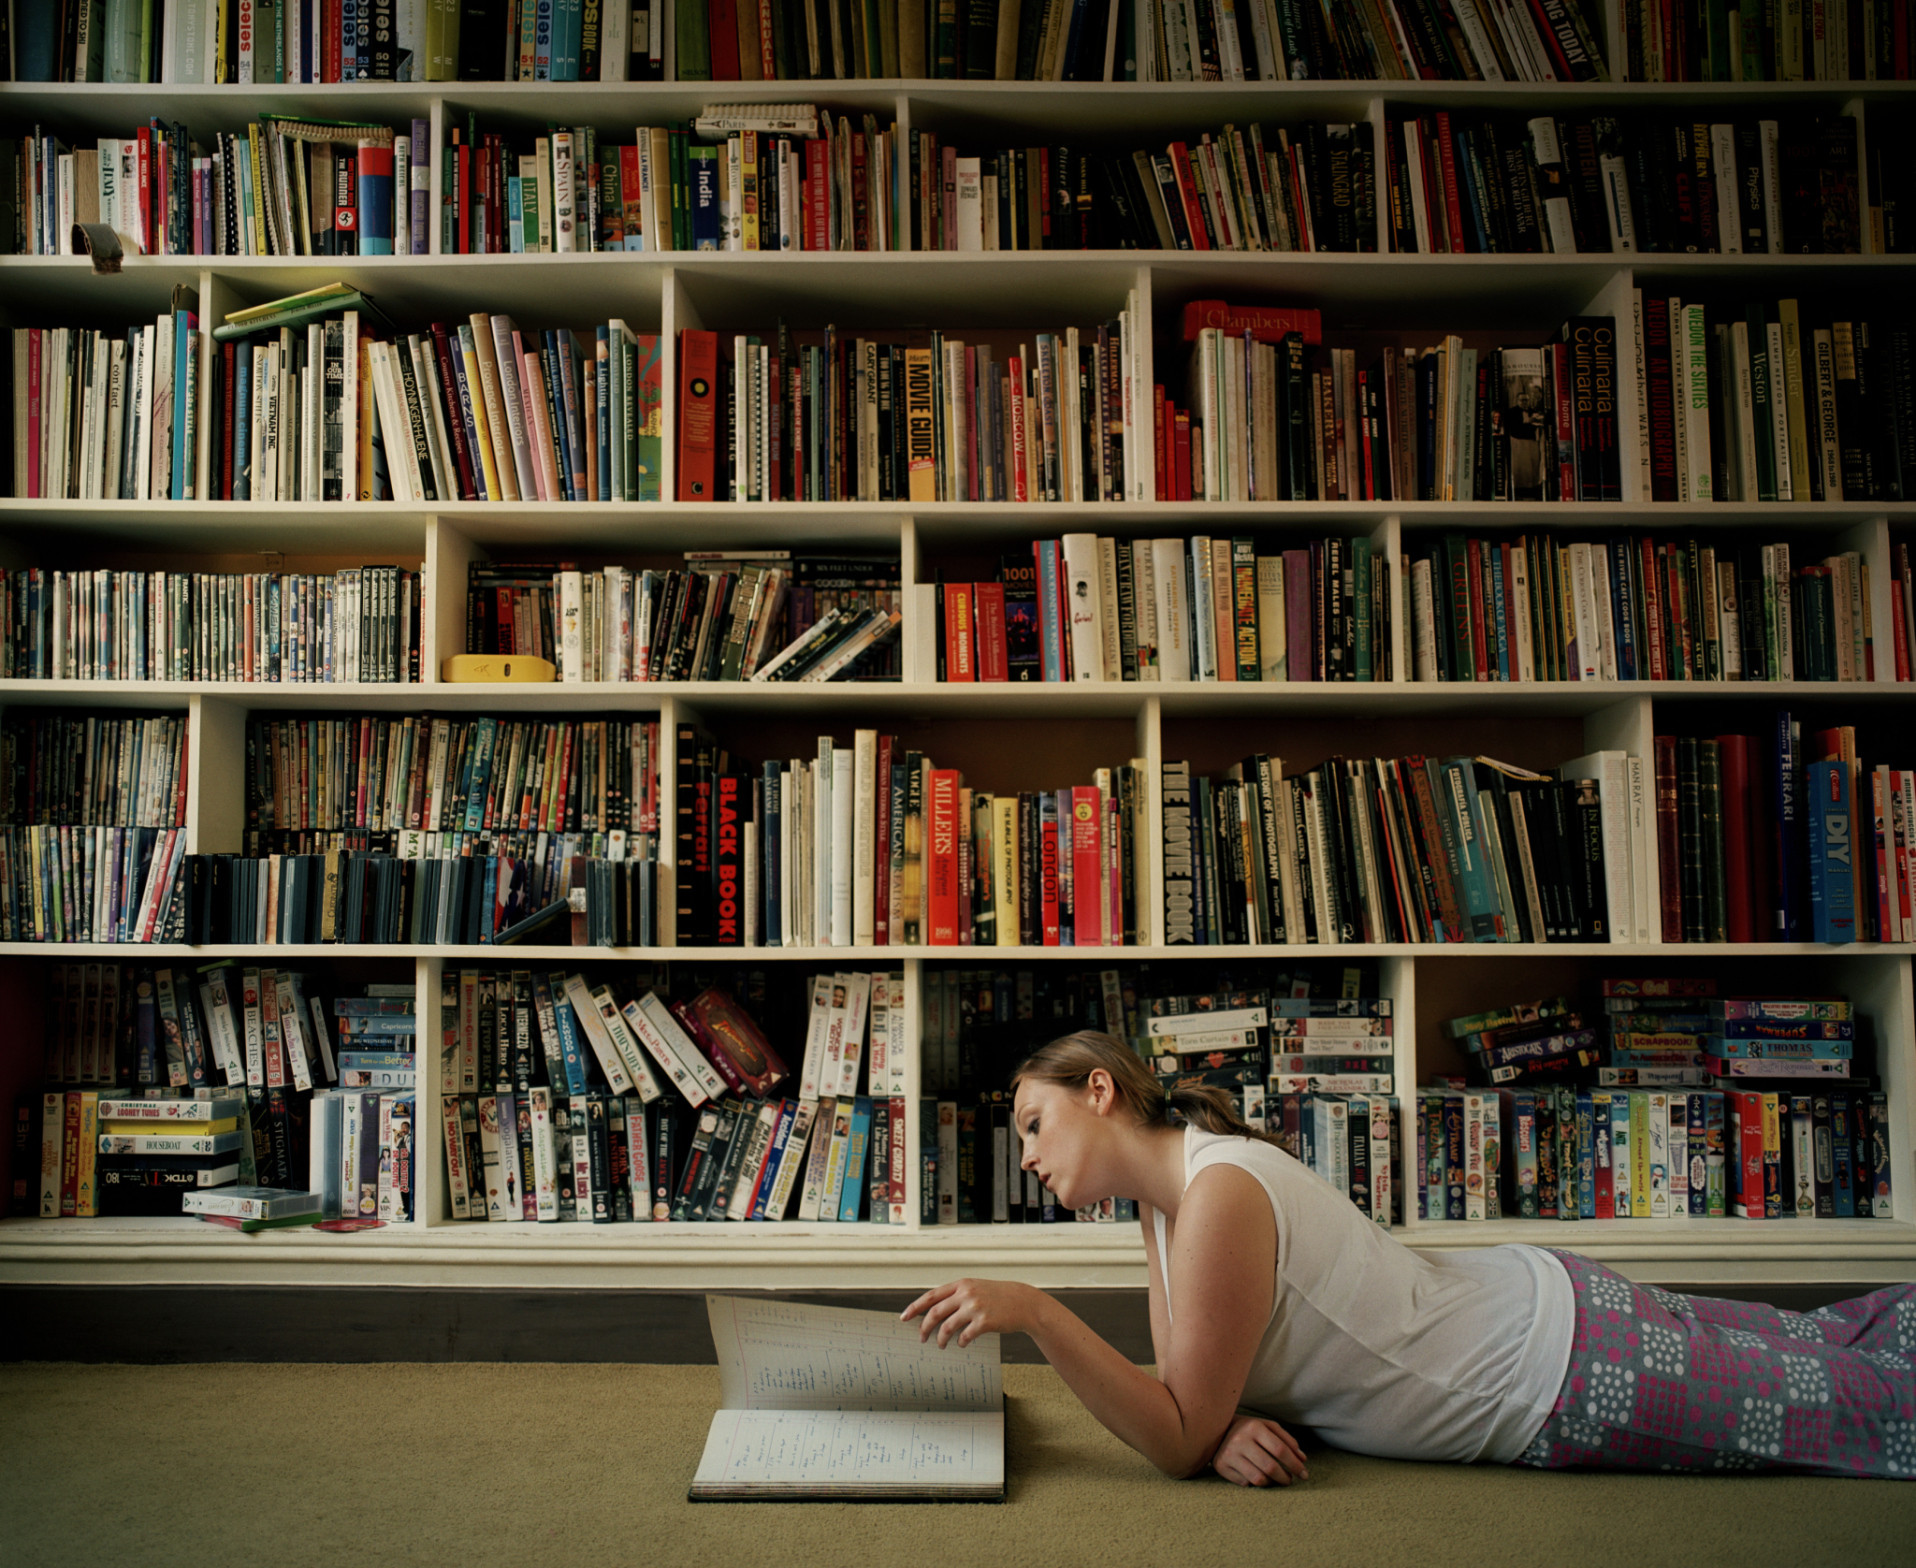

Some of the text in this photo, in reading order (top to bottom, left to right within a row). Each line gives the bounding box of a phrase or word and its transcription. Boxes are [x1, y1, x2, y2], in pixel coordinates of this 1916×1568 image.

[240, 0, 251, 52] selec
[582, 25, 596, 51] BOOK
[1556, 23, 1588, 65] TODAY
[343, 57, 355, 65] 52
[357, 56, 369, 64] 53
[376, 52, 389, 61] 50
[521, 55, 534, 63] 51
[537, 56, 549, 64] 52
[1575, 124, 1598, 176] ROTTEN
[1693, 123, 1706, 177] HEPBURN
[337, 158, 349, 207] THE RUNNER
[522, 181, 537, 214] ITALY
[557, 161, 569, 203] SPAIN
[602, 164, 617, 203] China
[698, 170, 712, 208] India
[730, 165, 740, 190] ROME
[1330, 150, 1350, 207] STALINGRAD
[1505, 150, 1526, 233] FIRST WORLD WAR
[1676, 173, 1692, 224] CLIFT
[1747, 167, 1762, 210] Physics
[1614, 171, 1630, 239] NOTORIOUS
[1206, 309, 1290, 330] Chambers
[866, 345, 876, 405] CARY GRANT
[1109, 336, 1120, 390] HILLERMAN
[1574, 326, 1595, 413] Culinaria
[1593, 327, 1614, 414] Culinaria
[1688, 307, 1708, 409] AVEDON THE SIXTIES
[1752, 352, 1767, 404] Weston
[1786, 322, 1800, 398] August Sander
[1817, 342, 1832, 387] GILBERT
[440, 356, 464, 454] Country Kitchens & Recipes
[457, 372, 476, 428] BARNS
[482, 361, 506, 457] Provence Interiors
[502, 360, 526, 446] London Interiors
[598, 368, 609, 408] Lighting
[1040, 345, 1053, 426] SKELETON COAST
[1321, 375, 1334, 440] BAKERY
[1646, 299, 1674, 478] AVEDON AN AUTOBIOGRAPHY
[1772, 331, 1787, 466] HELMUT NEWTON PORTRAITS
[237, 366, 248, 466] magnum cinema
[268, 395, 277, 450] VIETNAM INC.
[403, 372, 428, 461] HOYNINGEN-HUENE
[626, 395, 634, 441] REVEALED
[728, 392, 737, 462] LIGHTING
[909, 364, 932, 461] MOVIE GUIDE
[1012, 394, 1024, 453] MOSCOW
[1561, 399, 1571, 428] home
[1820, 400, 1836, 443] GEORGE
[1828, 472, 1837, 487] 1980
[1003, 567, 1035, 580] 1001
[1330, 541, 1340, 615] REBEL MALES
[1616, 544, 1631, 644] THE RIVER CAFE COOK BOOK
[1235, 566, 1257, 666] IMMEDIATE ACTION
[1452, 561, 1469, 641] GREENS
[957, 592, 969, 674] CURIOUS MOMENTS
[880, 749, 889, 842] VICTORIAN INTERIOR STYLE
[908, 769, 920, 808] VOGUE
[1259, 762, 1272, 799] HISTORY
[1263, 800, 1272, 812] OF
[1451, 768, 1473, 841] FOTOGRAFÍA PÚBLICA
[1631, 762, 1642, 804] MAN RAY
[1781, 754, 1794, 821] FERRARI
[1831, 777, 1839, 801] Collins
[695, 782, 710, 872] Ferrari
[935, 777, 952, 855] MILLER'S
[1292, 787, 1306, 859] SMALLER GARDEN
[1588, 809, 1600, 861] IN FOCUS
[1825, 814, 1850, 865] DIY
[718, 777, 737, 944] BLACK BOOK!
[892, 786, 905, 920] AMERICAN REALISM
[1043, 829, 1058, 904] London
[1162, 760, 1194, 944] THE MOVIE BOOK
[1265, 814, 1279, 880] PHOTOGRAPHY
[1442, 819, 1459, 875] LUCIAN FREUD
[247, 1010, 258, 1067] BEACHES
[482, 1030, 492, 1078] TOP HAT
[499, 1006, 510, 1065] LOCAL HERO
[516, 1008, 529, 1050] INTERMEZZO
[612, 1025, 638, 1074] THAT'S LIFE!
[1766, 1043, 1813, 1052] THOMAS
[273, 1121, 286, 1180] STIGMATA
[447, 1121, 460, 1177] NO WAY OUT
[502, 1120, 516, 1171] yogalates
[629, 1116, 645, 1182] FATHER GOOSE
[774, 1113, 793, 1151] Accident
[892, 1118, 904, 1184] SWEET CHARITY
[1354, 1135, 1366, 1167] ITALIAN
[1428, 1110, 1443, 1159] TARZAN
[1450, 1132, 1459, 1162] TRAMP
[105, 1172, 120, 1183] 180
[165, 1174, 186, 1182] TDK
[523, 1147, 532, 1191] DAUGHTER
[576, 1162, 588, 1199] Mr. Lucky
[610, 1134, 618, 1185] YESTERDAY
[619, 1146, 628, 1174] BORN
